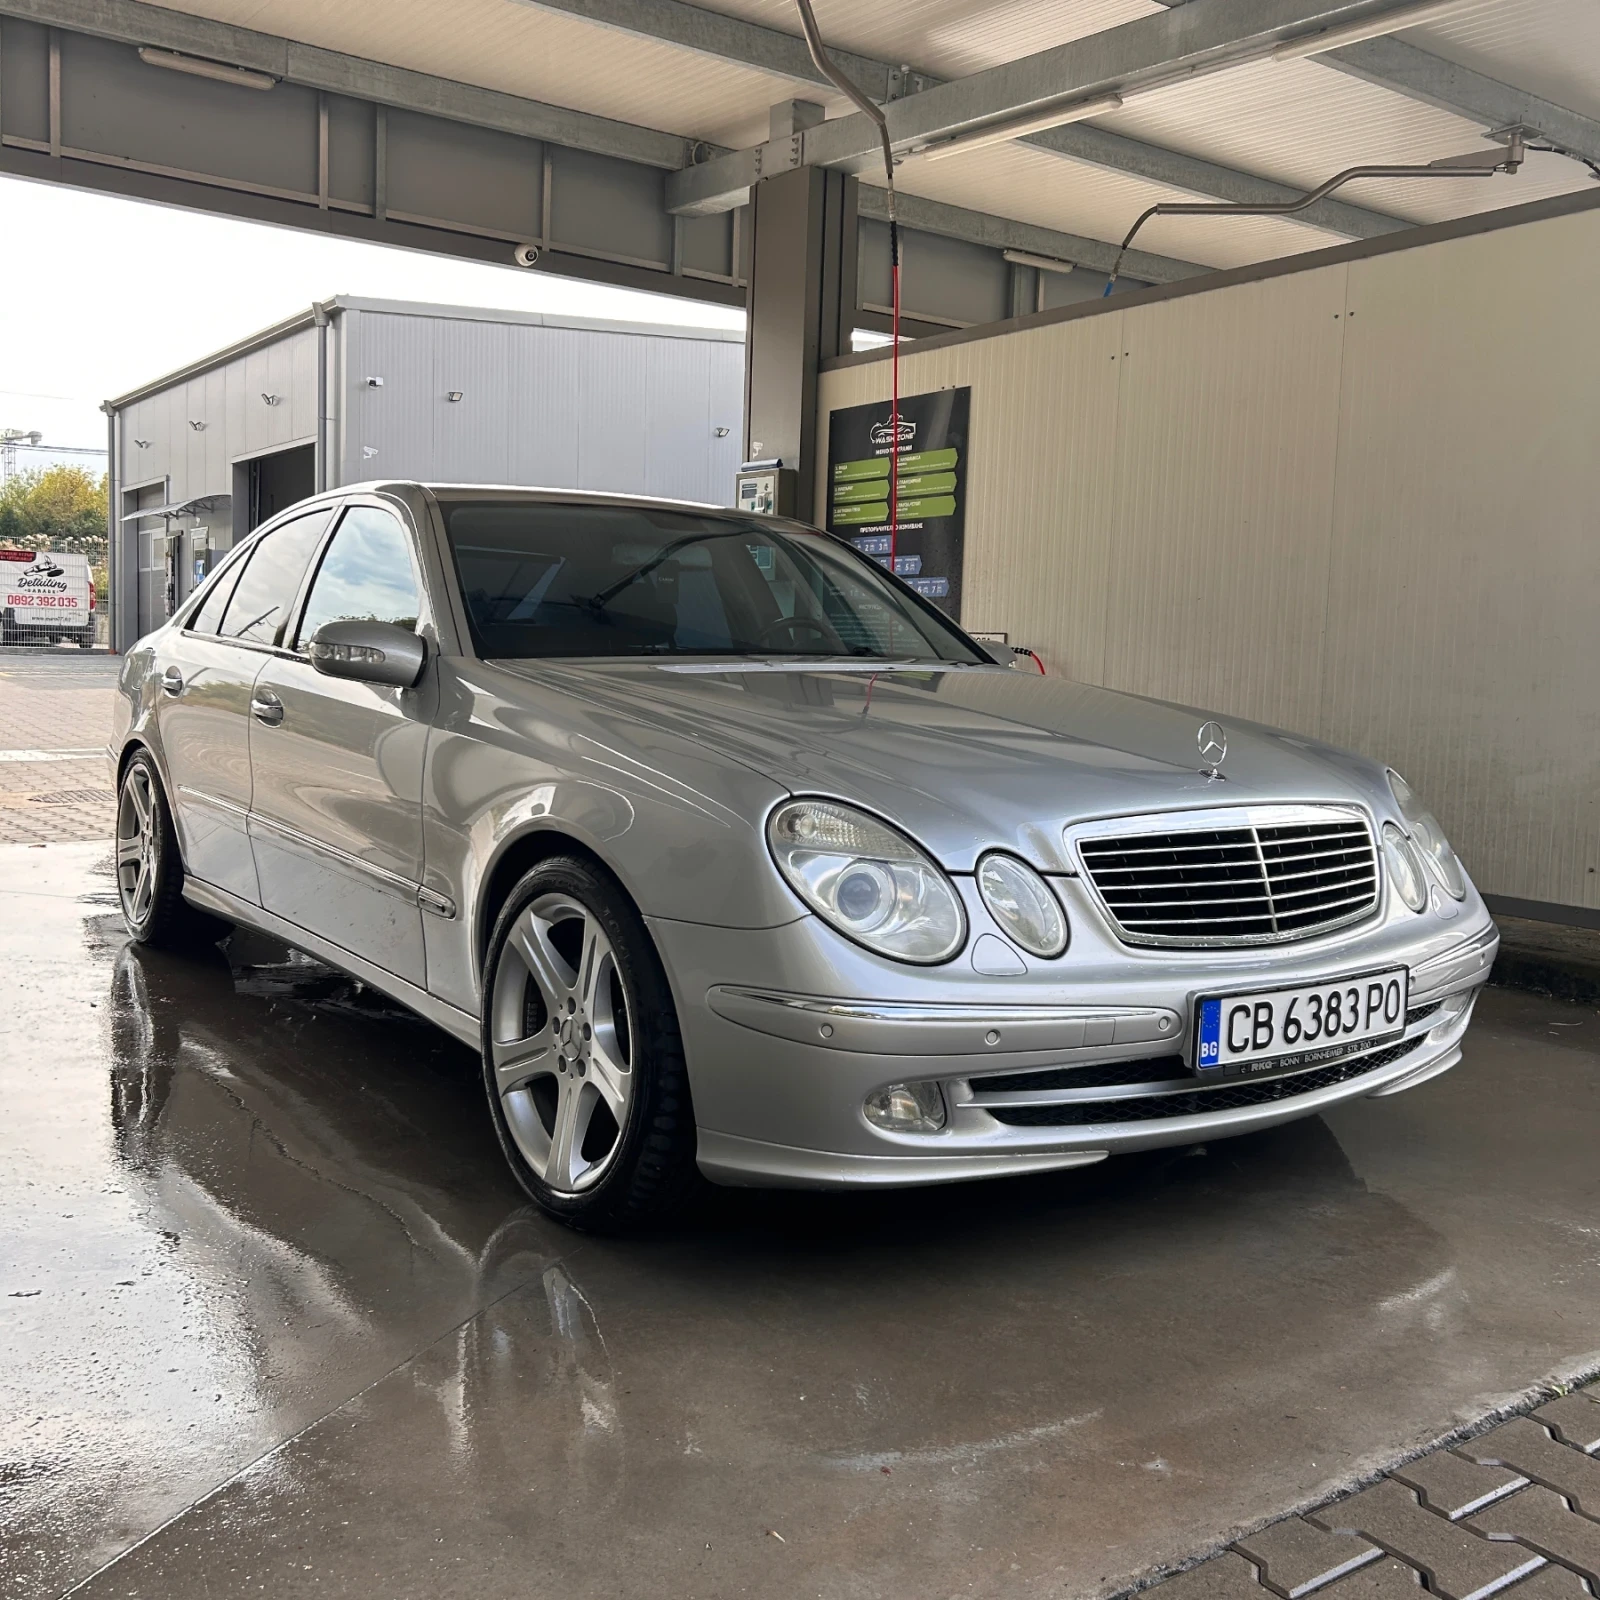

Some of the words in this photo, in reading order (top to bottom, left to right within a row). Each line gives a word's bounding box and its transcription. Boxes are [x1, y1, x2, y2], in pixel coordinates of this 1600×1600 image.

[860, 525, 898, 533] ПРЕПОРЪЧИТЕЛО
[8, 595, 34, 606] 0892
[36, 596, 56, 607] 392
[58, 597, 78, 608] 035
[1227, 1001, 1274, 1054] CB
[1283, 987, 1360, 1045] 6383
[1365, 979, 1400, 1030] PO
[1201, 1042, 1217, 1057] BG
[1251, 1060, 1274, 1071] RKG
[1280, 1056, 1300, 1067] BONN
[1304, 1048, 1343, 1063] BORNHEIMER
